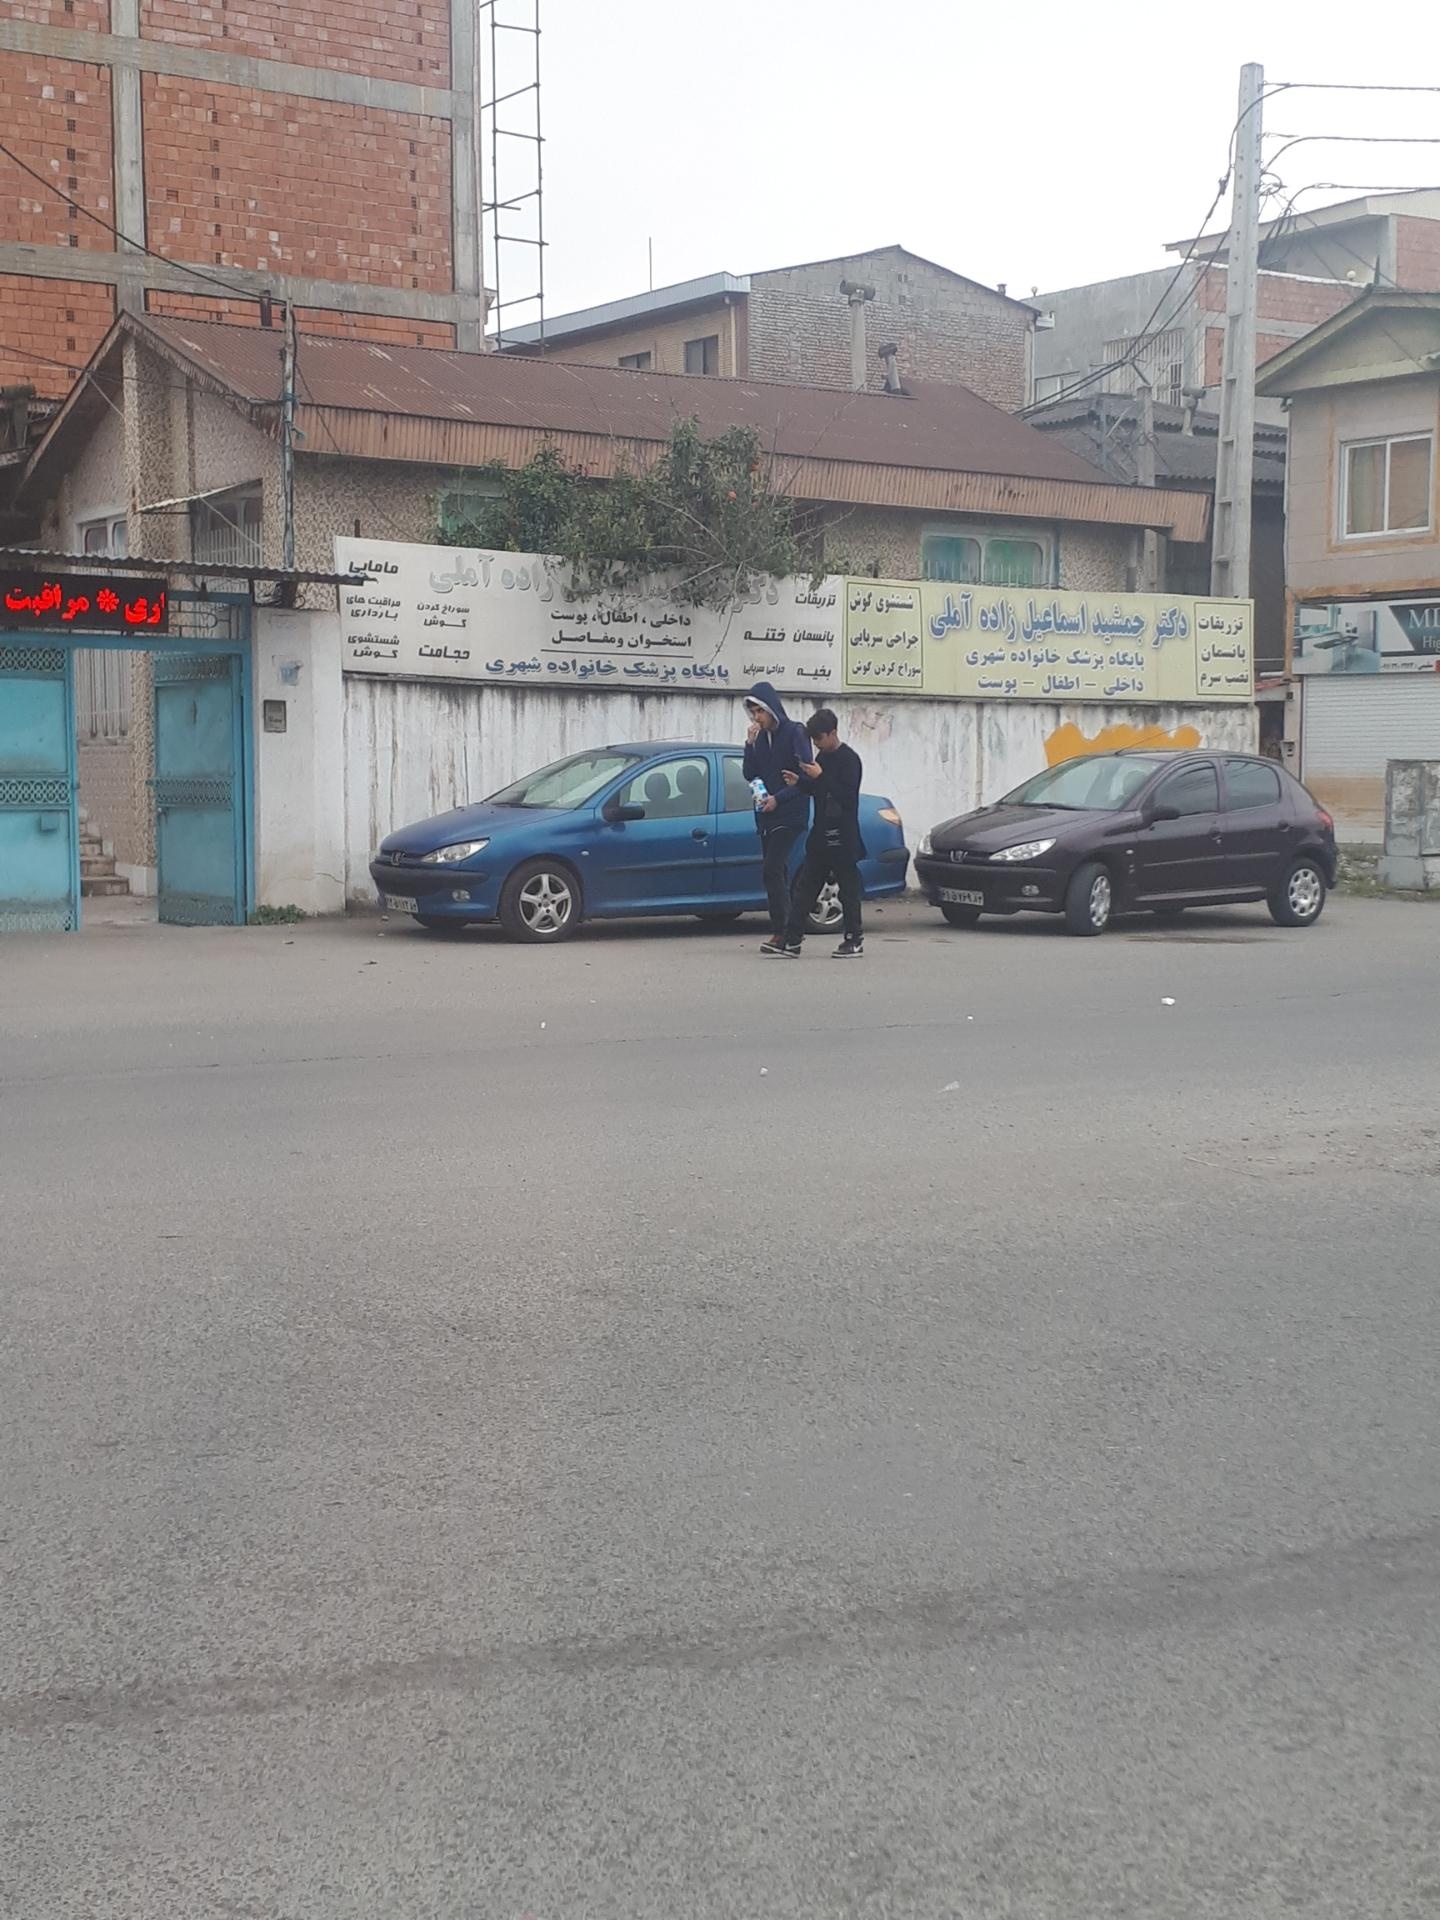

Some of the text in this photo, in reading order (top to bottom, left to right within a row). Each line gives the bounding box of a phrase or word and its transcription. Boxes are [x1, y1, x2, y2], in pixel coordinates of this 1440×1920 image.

[429, 553, 495, 593] آملی
[346, 595, 401, 608] مراقبت های
[417, 602, 440, 612] کردن
[795, 593, 837, 609] تزریقات
[850, 591, 914, 613] شستشوی گوش
[351, 608, 399, 621] بارداری
[551, 610, 588, 625] پوست
[930, 592, 1190, 648] دکتر جمشید اسماعیل زاده آملی
[1198, 616, 1243, 635] تزریقات
[347, 632, 400, 645] شستشوی
[628, 633, 692, 648] استخوان
[743, 627, 835, 648] پانسمان ختنه
[850, 628, 919, 649] جراحی سرپایی
[418, 644, 470, 664] حجامت
[966, 647, 1145, 670] پایگاه پزشک خانواده شهری
[1201, 643, 1246, 663] پانسمان
[485, 656, 729, 683] پایگاه پزشک خانواده شهری
[796, 665, 832, 680] بخیه
[978, 676, 1018, 695] پوست
[1042, 675, 1080, 692] اطفال
[1104, 677, 1144, 696] داخلی
[1200, 672, 1221, 687] سرم
